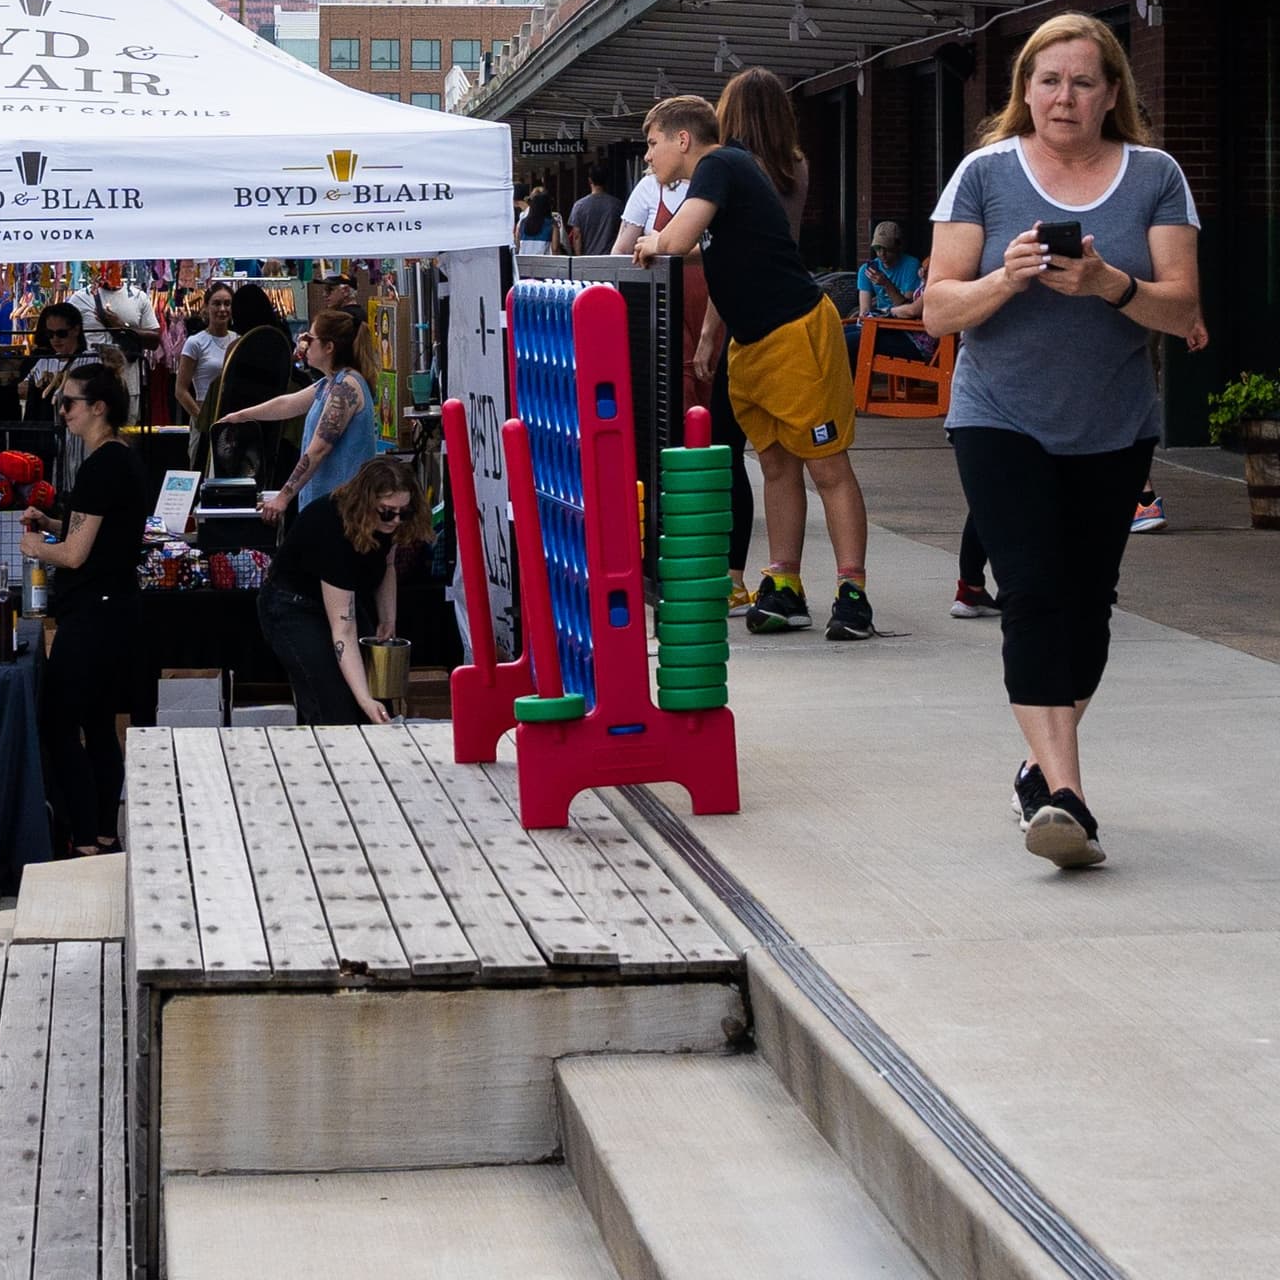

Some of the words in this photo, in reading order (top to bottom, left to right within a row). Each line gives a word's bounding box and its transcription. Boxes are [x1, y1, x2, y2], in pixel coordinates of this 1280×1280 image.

[115, 45, 200, 61] &
[81, 106, 232, 118] COCKTAILS
[522, 140, 585, 153] Puttshack
[11, 191, 40, 206] &
[41, 187, 144, 210] BLAIR
[233, 185, 318, 208] BOYD
[322, 188, 351, 201] &
[352, 182, 454, 204] BLAIR
[40, 228, 95, 240] VODKA
[268, 223, 321, 236] CRAFT
[330, 220, 423, 234] COCKTAILS
